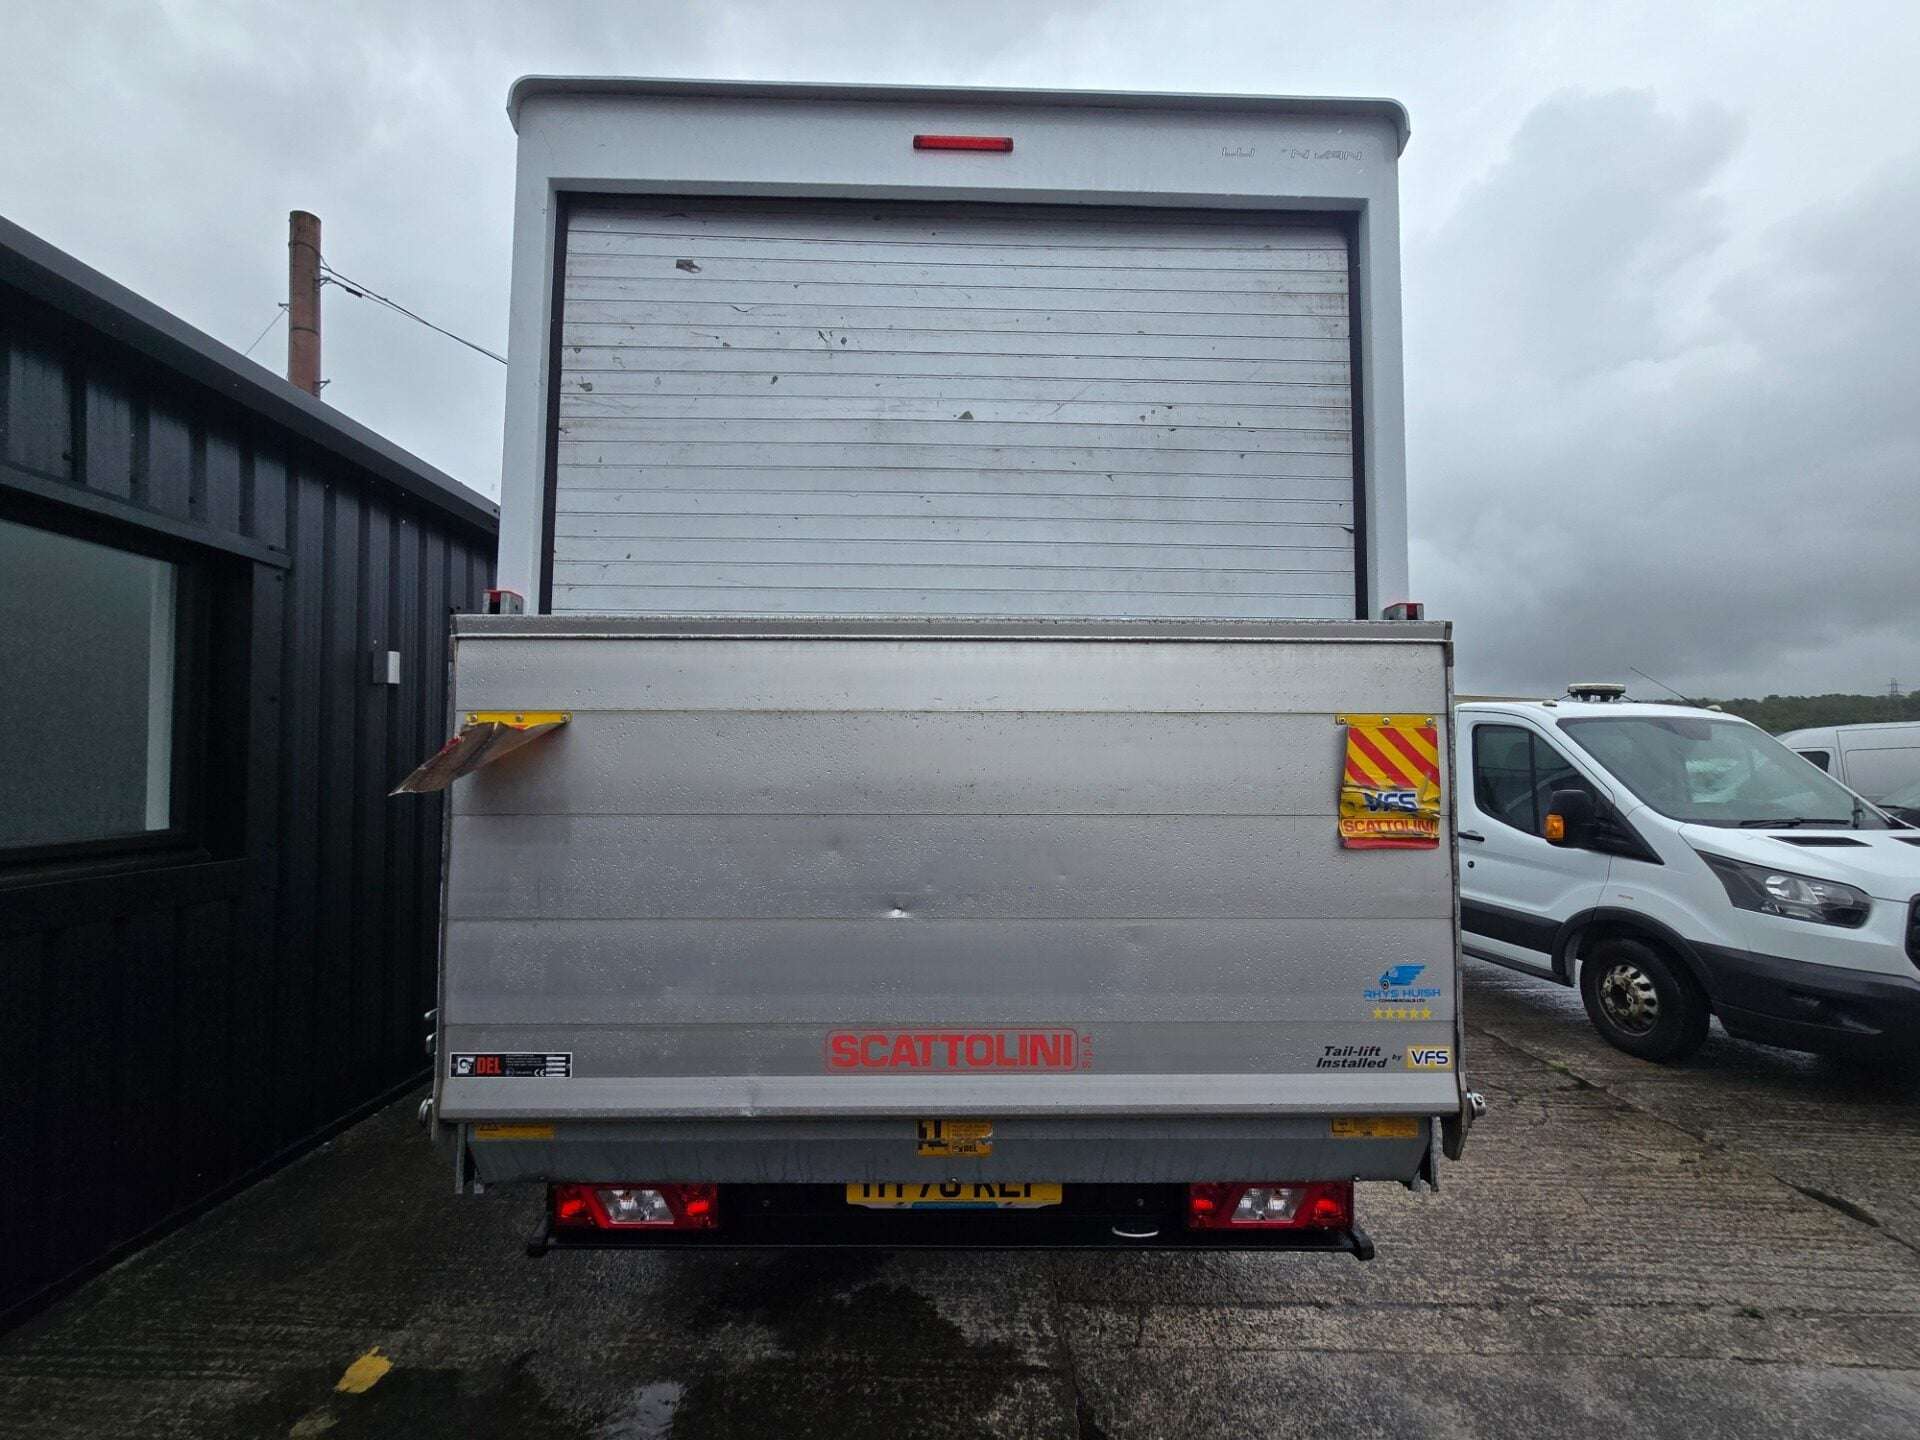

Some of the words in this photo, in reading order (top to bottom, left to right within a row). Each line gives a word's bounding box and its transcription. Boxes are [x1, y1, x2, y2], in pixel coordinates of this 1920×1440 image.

[1364, 792, 1418, 812] VFS
[831, 1034, 1073, 1067] SCATTOLINI
[1316, 1057, 1388, 1069] Installed
[1392, 1053, 1403, 1062] by
[1411, 1050, 1450, 1065] VFS
[1324, 1045, 1382, 1057] Tail-lift
